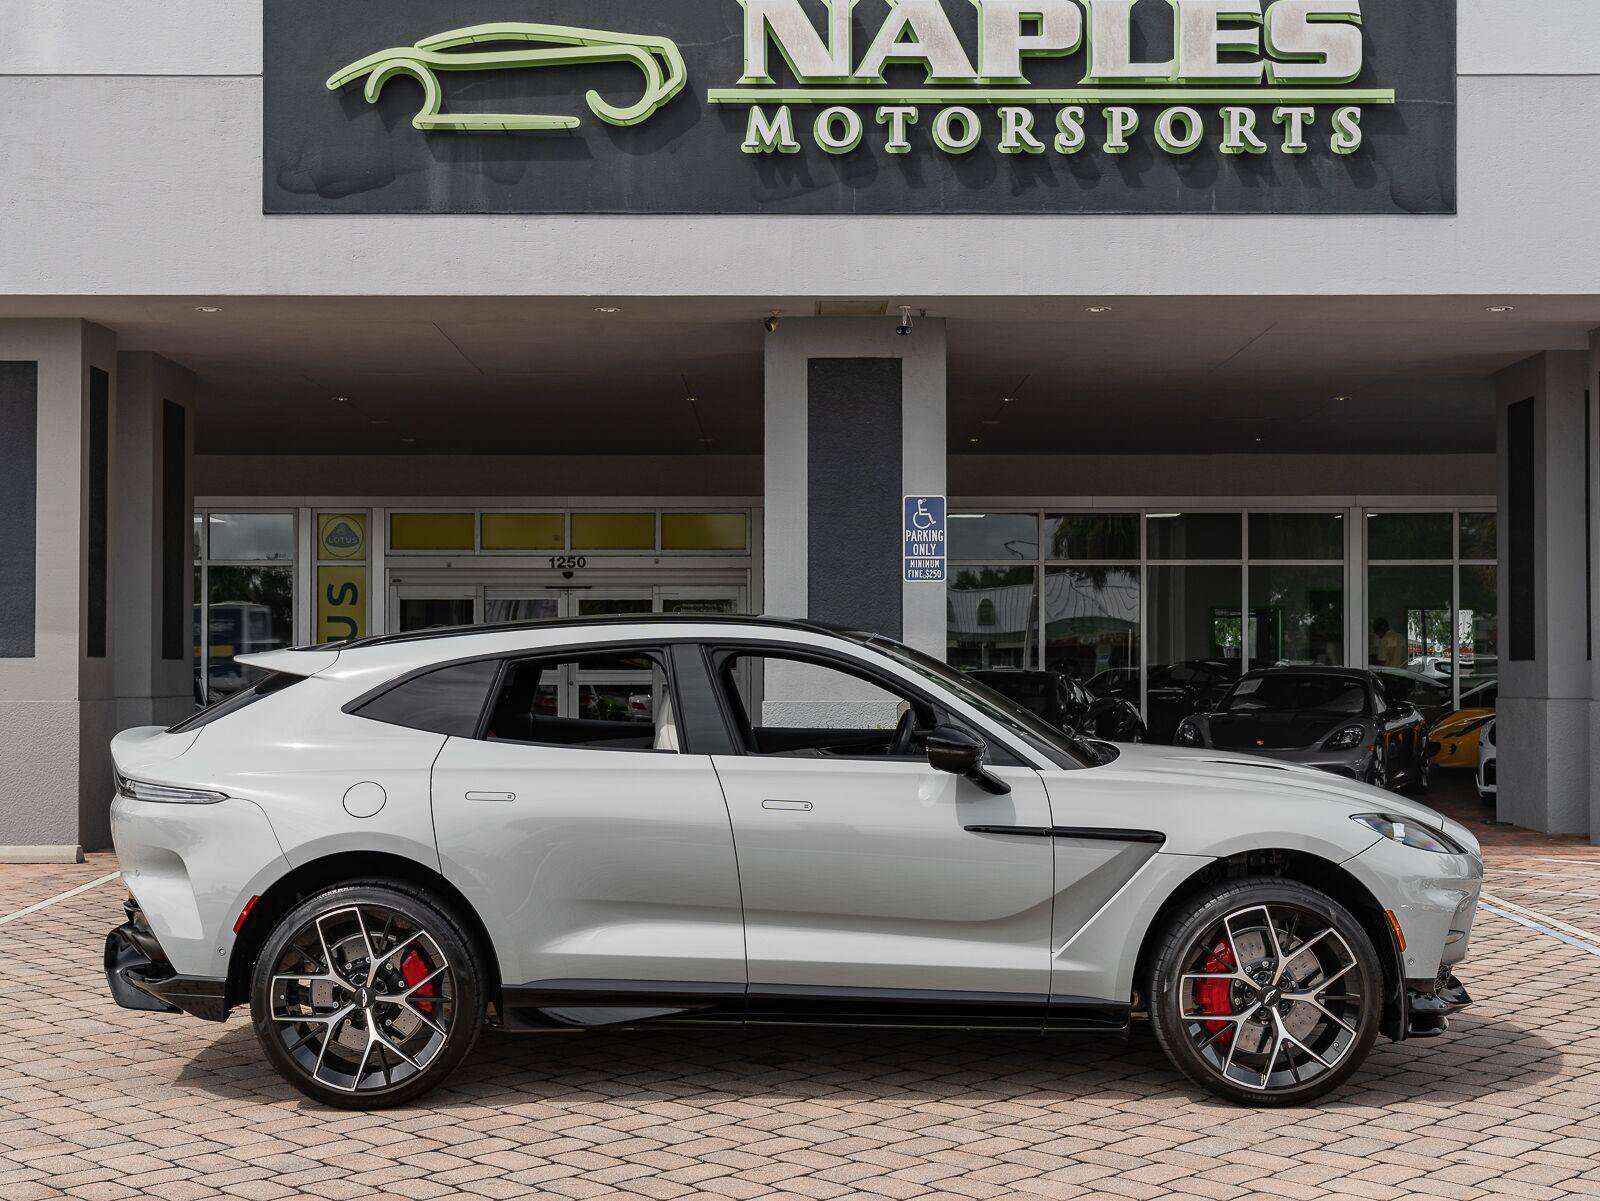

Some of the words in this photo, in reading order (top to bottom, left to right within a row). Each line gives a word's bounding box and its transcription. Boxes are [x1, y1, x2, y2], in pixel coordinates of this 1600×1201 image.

[737, 0, 1362, 84] NAPLES
[741, 105, 1362, 153] MOTORSPORTS
[328, 536, 358, 544] LOTUS
[905, 530, 944, 542] PARKING
[912, 544, 936, 555] ONLY
[549, 556, 587, 568] 1250
[910, 559, 940, 568] MINIMUM
[908, 570, 924, 578] FINE
[925, 569, 942, 579] $250
